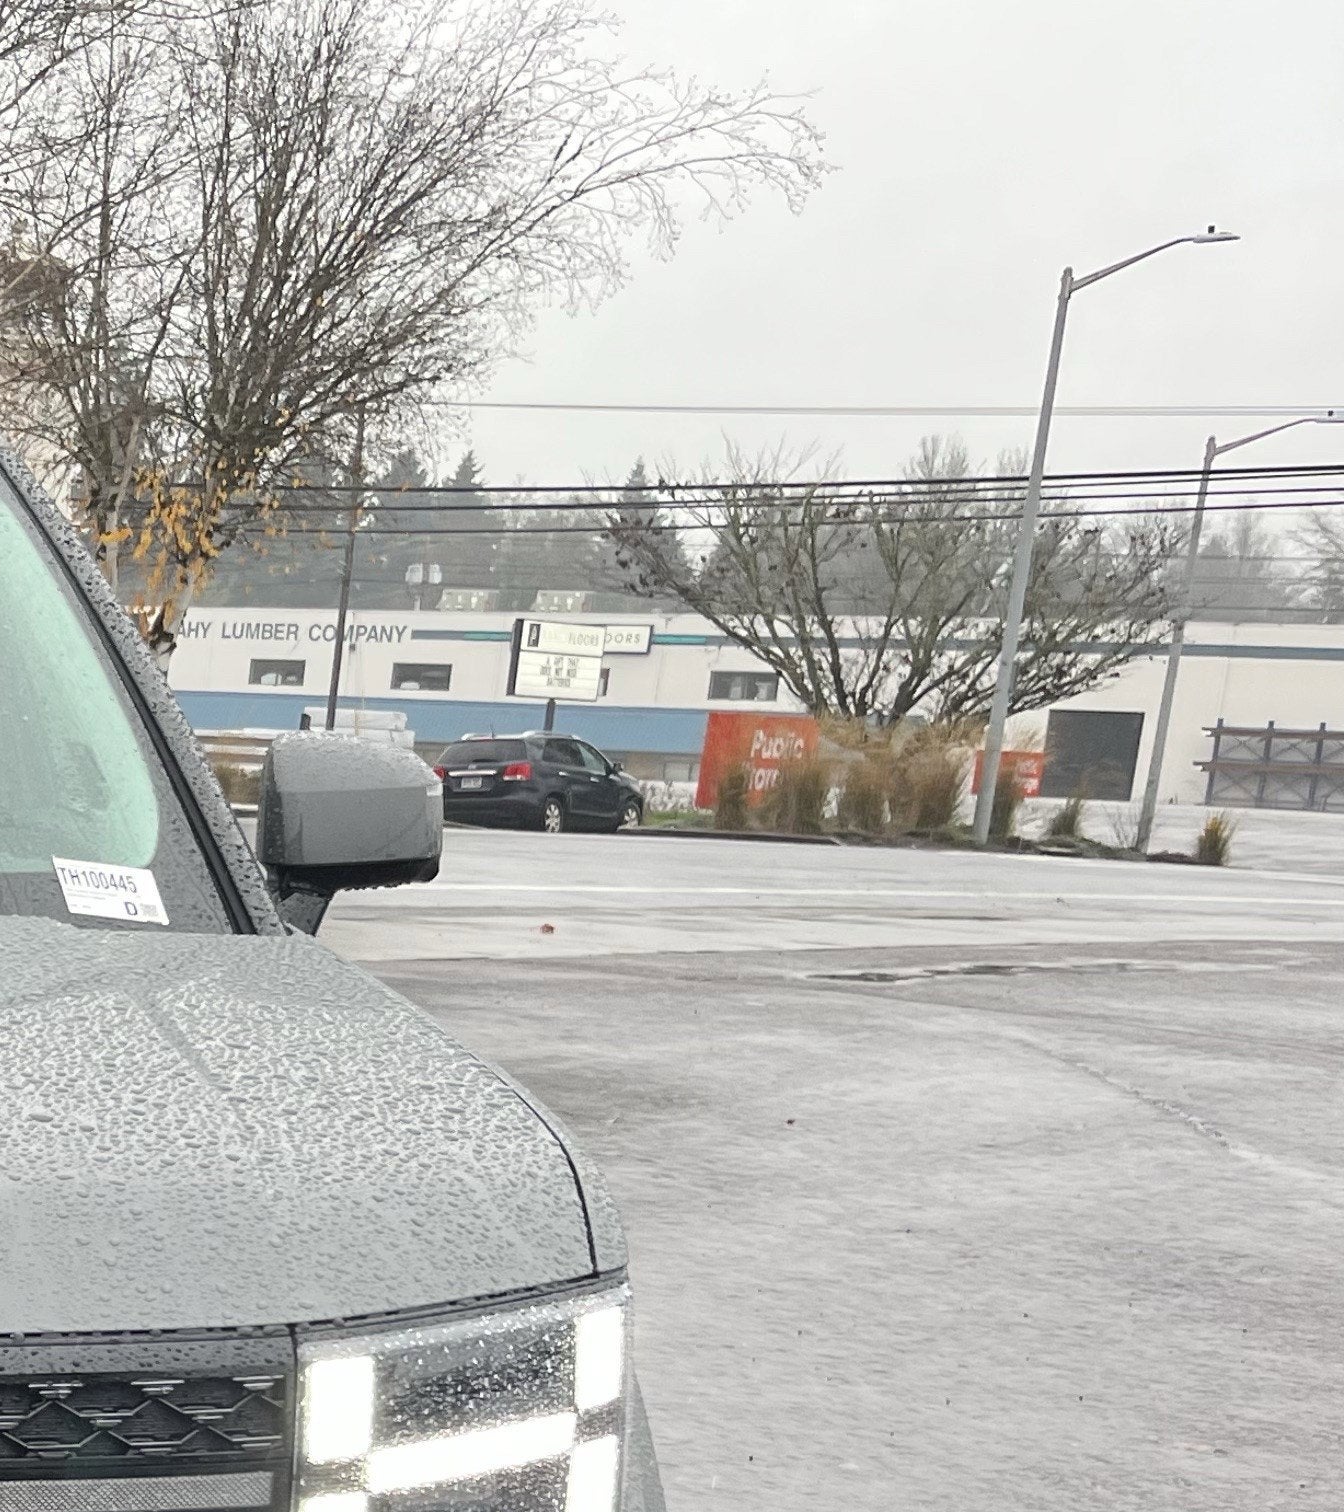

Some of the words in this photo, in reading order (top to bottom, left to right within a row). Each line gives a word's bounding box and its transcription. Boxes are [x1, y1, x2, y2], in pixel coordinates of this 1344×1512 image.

[221, 622, 299, 641] LUMBER
[308, 623, 408, 643] COMPANY
[57, 867, 138, 893] TH100445
